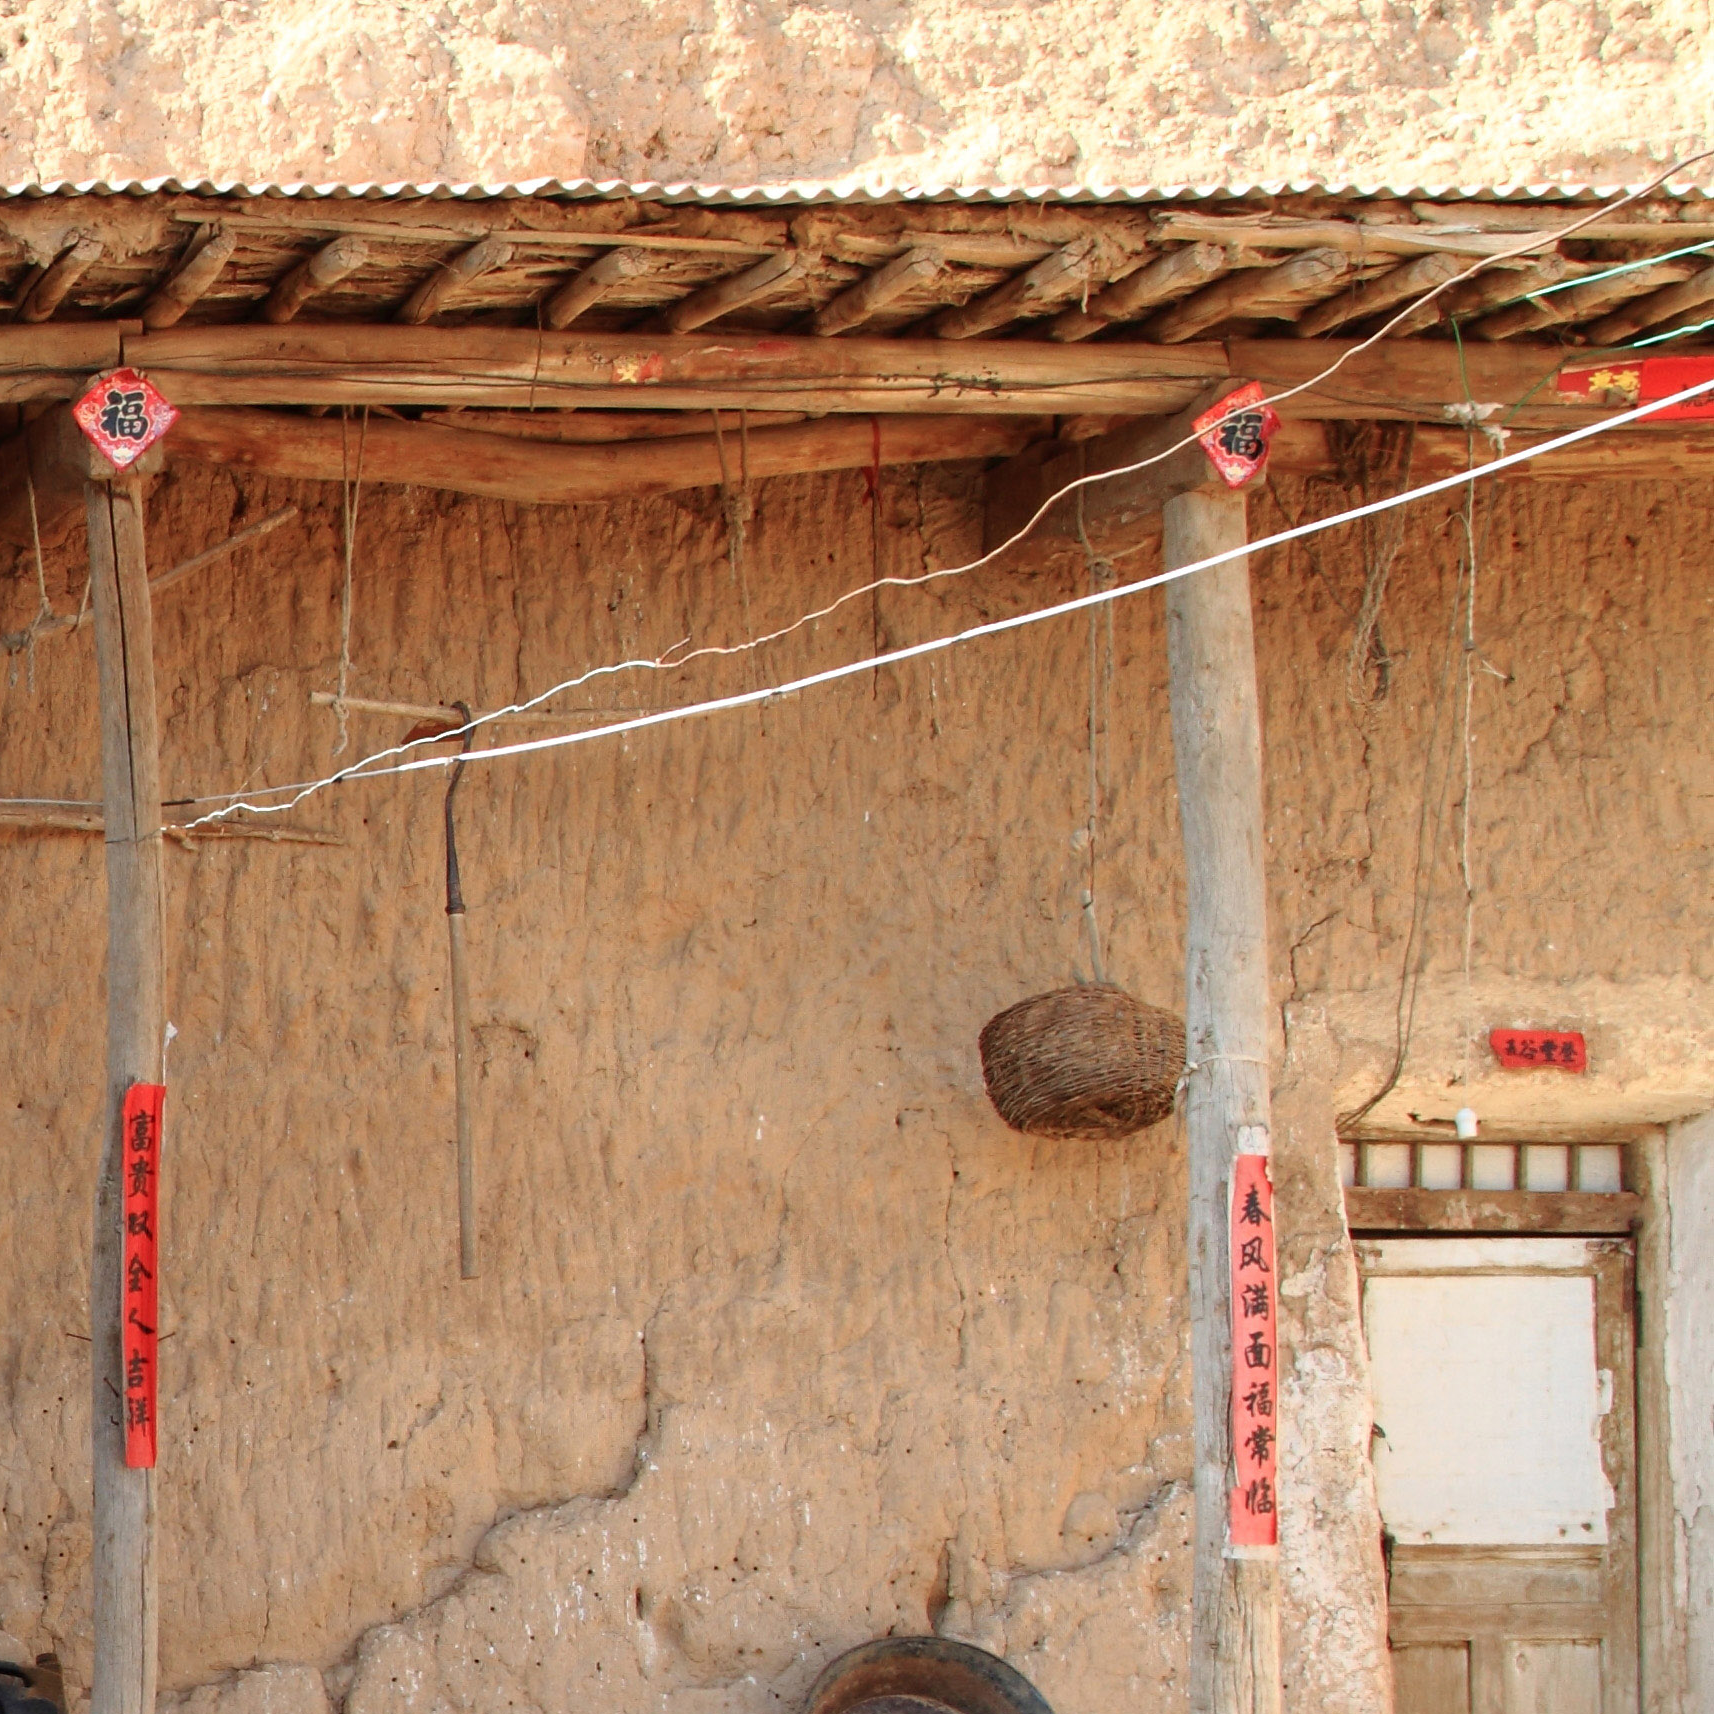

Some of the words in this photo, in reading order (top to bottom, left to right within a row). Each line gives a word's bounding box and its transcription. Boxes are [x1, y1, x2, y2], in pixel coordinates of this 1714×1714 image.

[99, 389, 150, 441] 福
[1219, 408, 1265, 461] 福
[126, 1108, 156, 1438] 富贵双全人吉祥
[1239, 1182, 1276, 1517] 春风满面福常临
